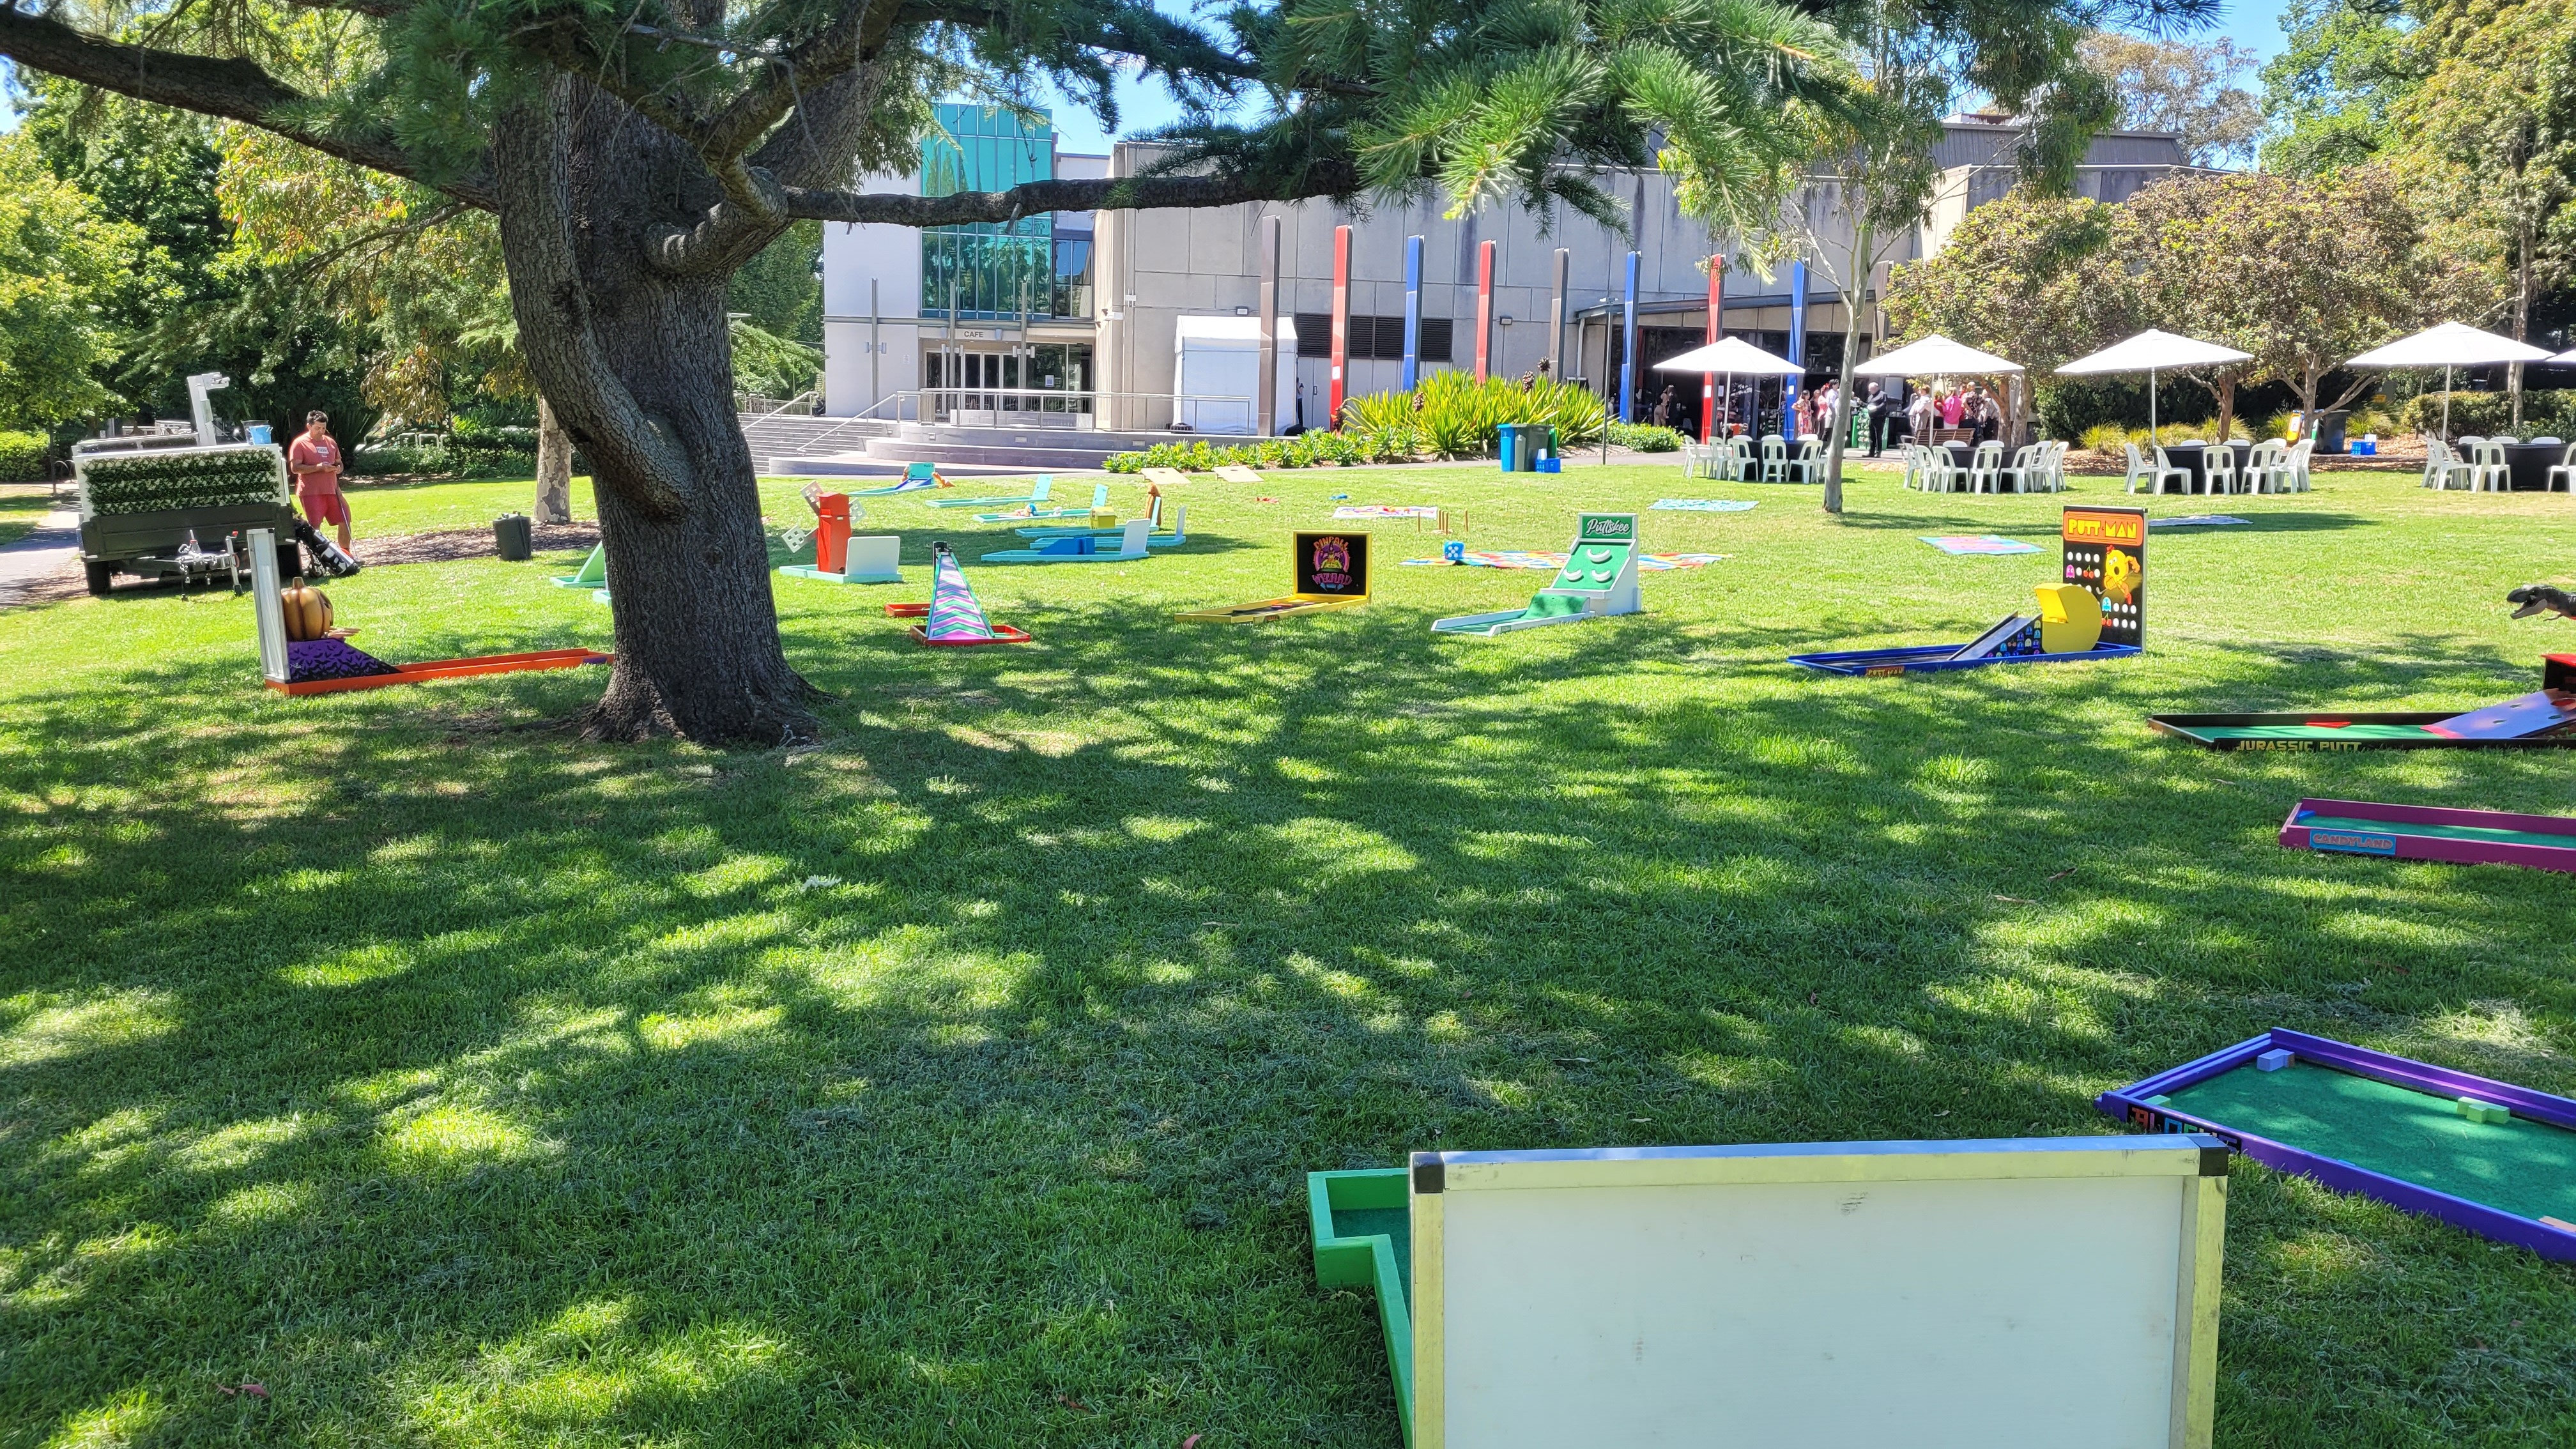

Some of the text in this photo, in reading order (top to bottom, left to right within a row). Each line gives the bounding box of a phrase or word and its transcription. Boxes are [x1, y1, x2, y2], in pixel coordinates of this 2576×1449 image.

[1586, 518, 1631, 535] Puttskee
[1312, 572, 1353, 585] WIZARD
[2236, 740, 2363, 752] JURASSIC PUTT
[2313, 834, 2393, 849] CANDYLAND
